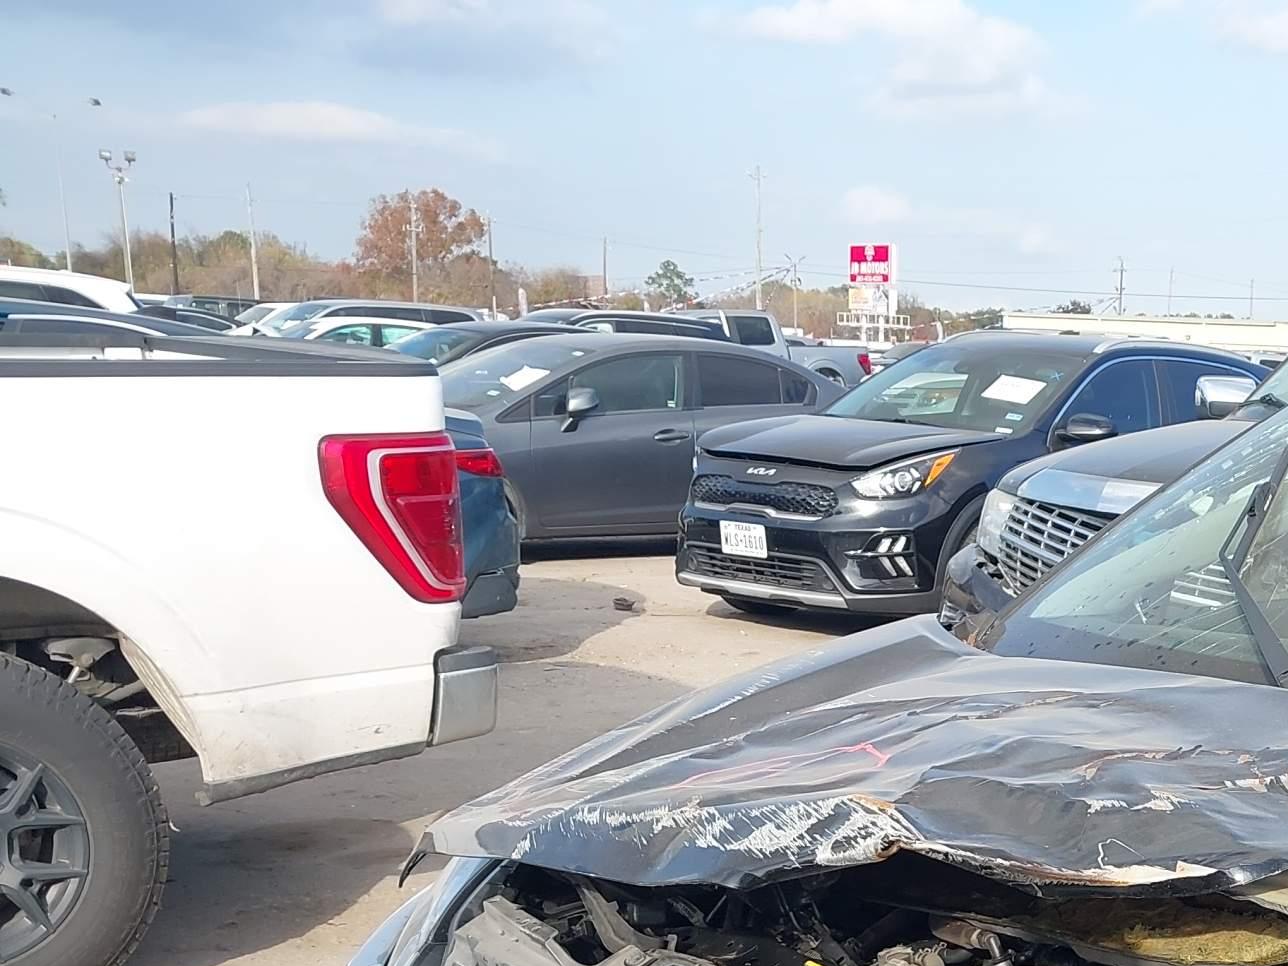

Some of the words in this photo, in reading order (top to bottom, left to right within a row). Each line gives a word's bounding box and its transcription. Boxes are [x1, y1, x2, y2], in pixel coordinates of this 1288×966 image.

[860, 261, 888, 275] MOTORS
[746, 466, 777, 476] KIA
[734, 524, 752, 532] TEXAS
